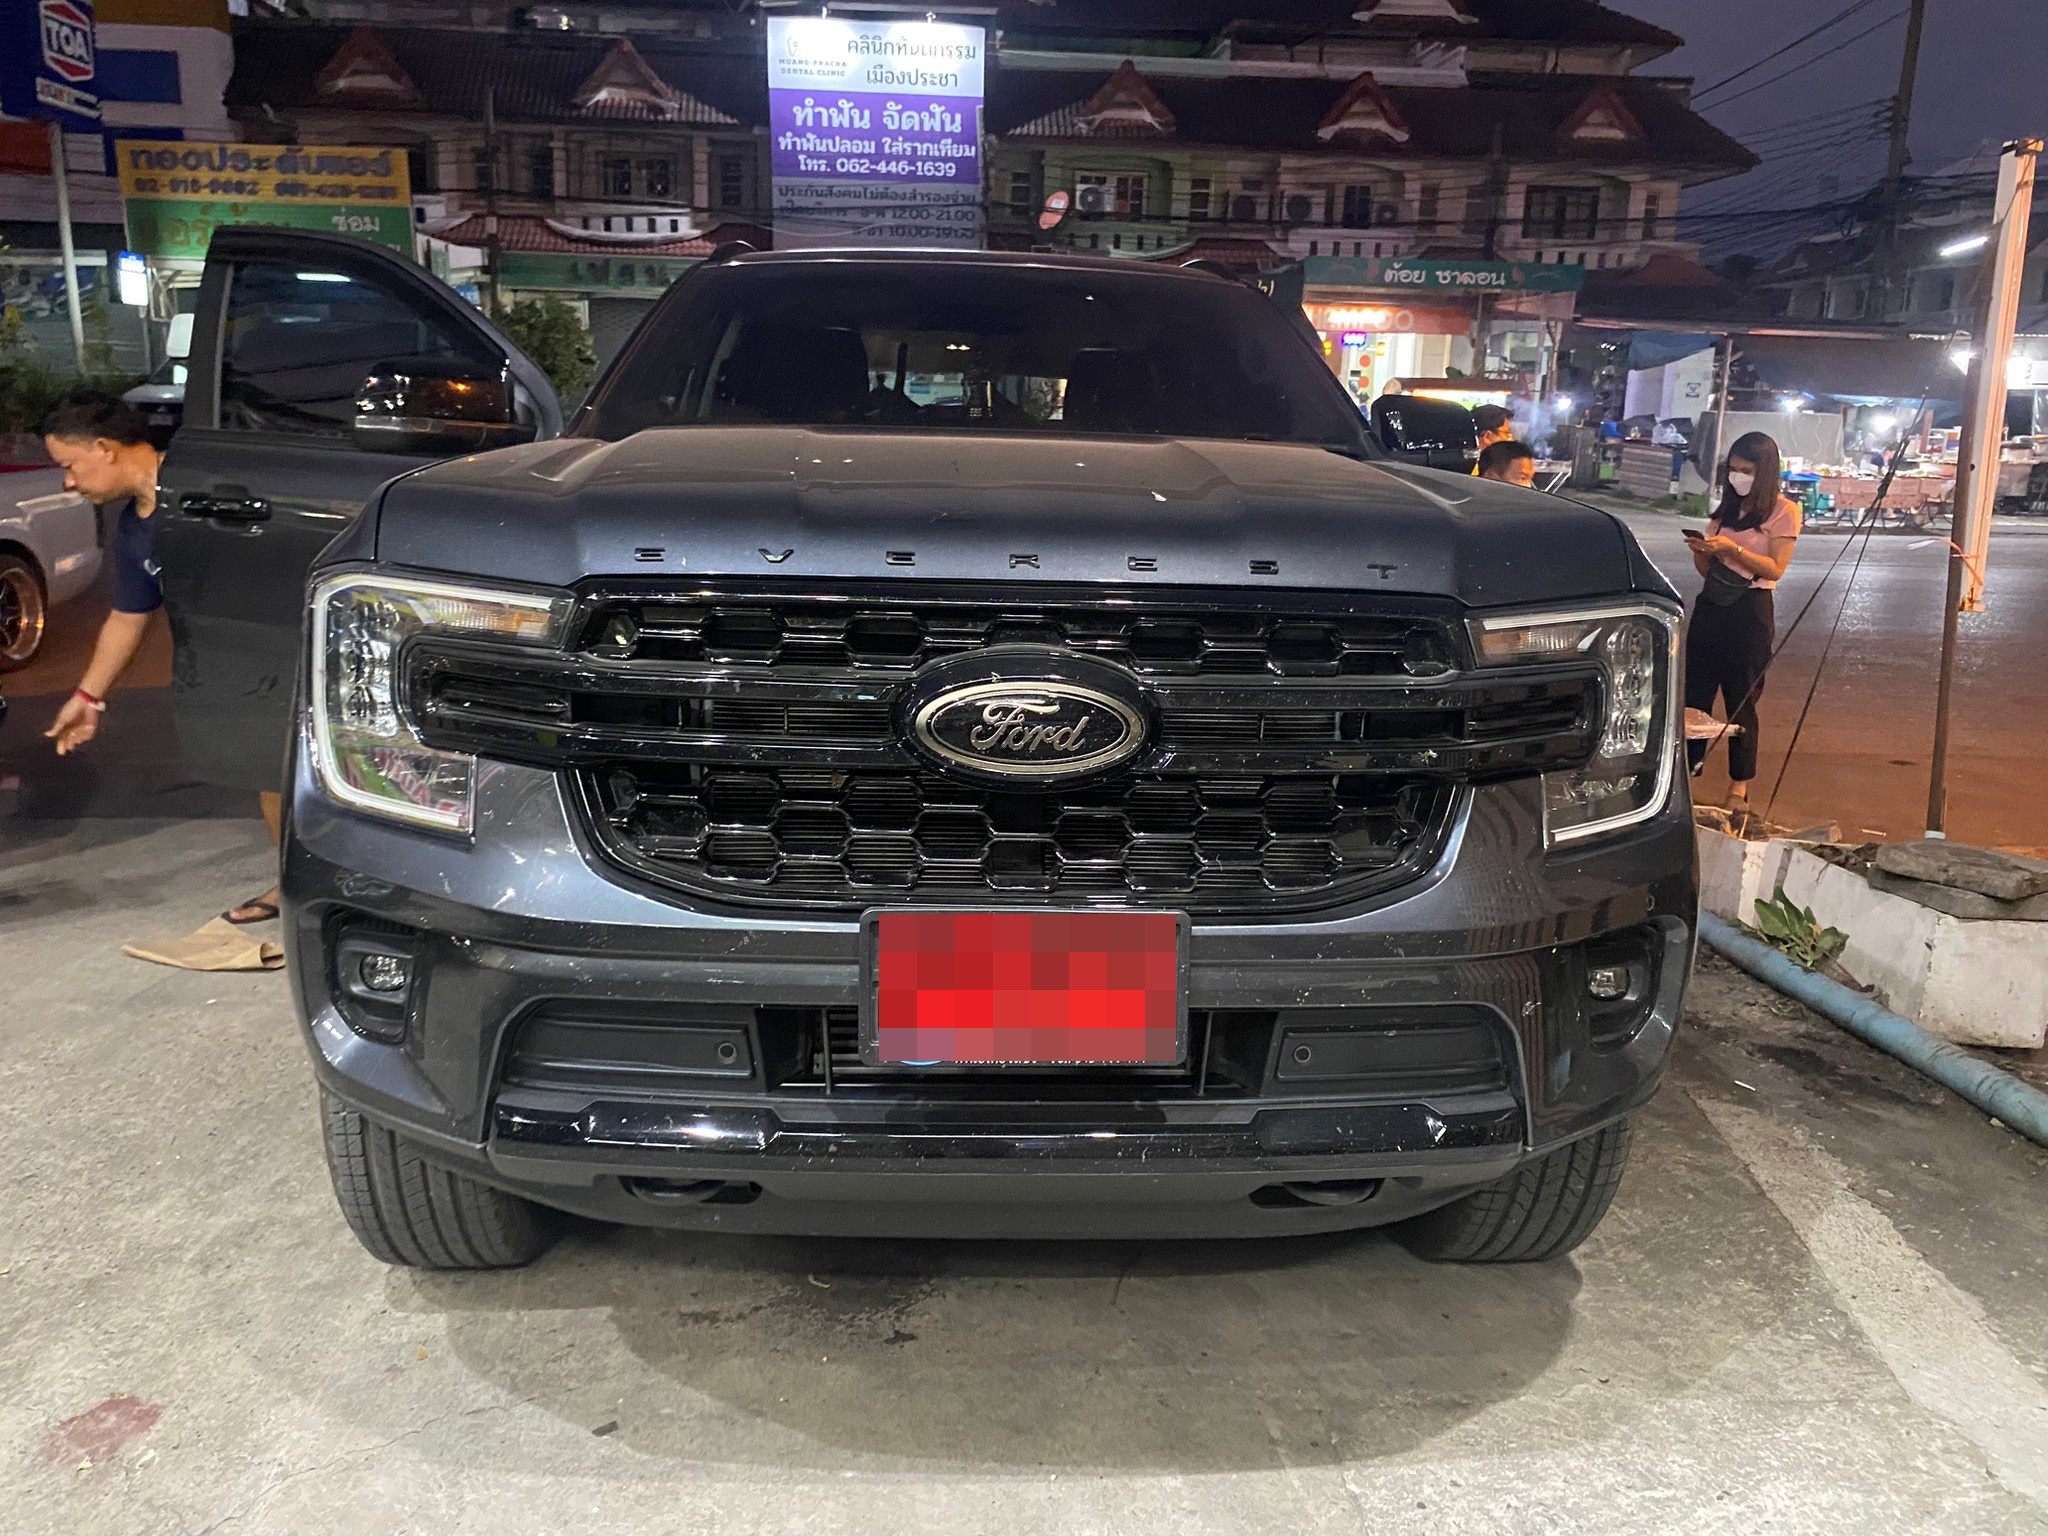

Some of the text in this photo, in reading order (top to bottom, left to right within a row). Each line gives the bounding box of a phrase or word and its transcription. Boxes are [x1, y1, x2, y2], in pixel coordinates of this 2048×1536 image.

[45, 19, 90, 63] TOA
[867, 64, 958, 88] เมืองประชา
[793, 97, 962, 133] ทำฟัน จัดฟัน
[778, 131, 976, 158] ทำฟันปลอม ใส่รากเทียม
[798, 155, 957, 177] โทร. 062-446-1639
[634, 547, 1398, 580] EVEREST
[970, 702, 1090, 751] Ford
